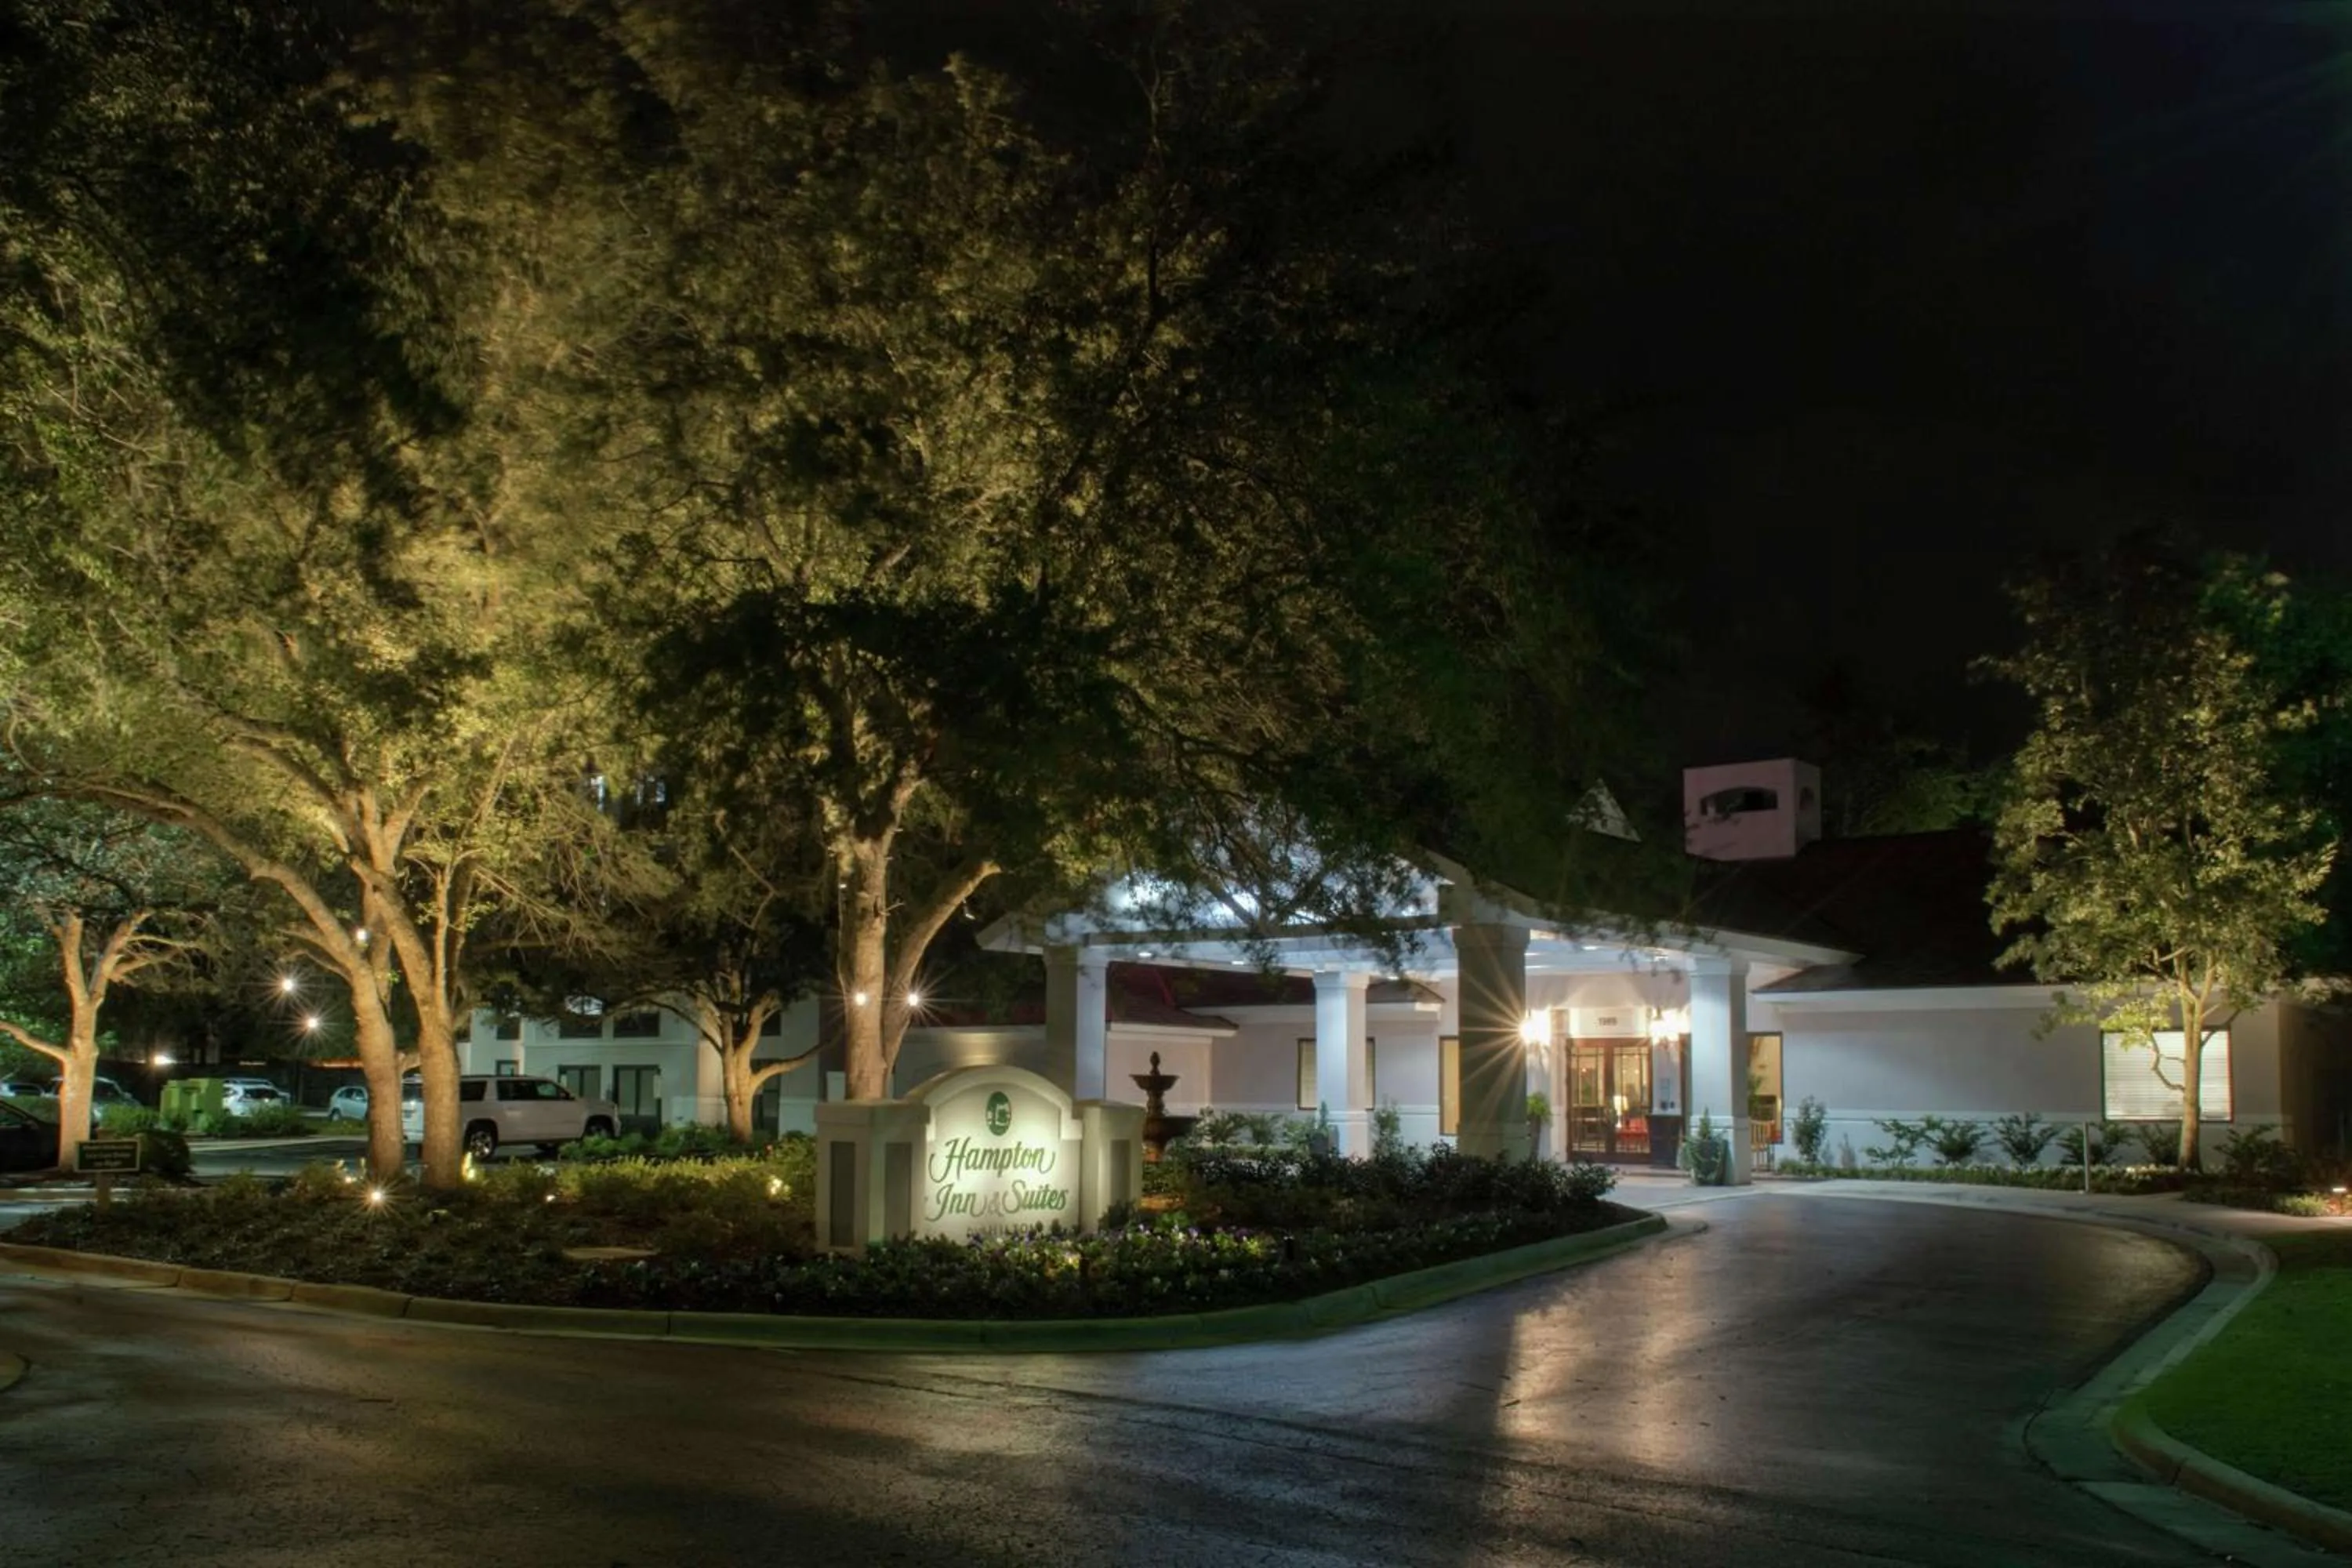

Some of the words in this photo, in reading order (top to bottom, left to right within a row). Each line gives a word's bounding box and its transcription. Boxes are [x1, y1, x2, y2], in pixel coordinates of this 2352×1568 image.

[928, 1137, 1055, 1183] Hampton
[925, 1182, 988, 1221] Inn
[987, 1190, 1004, 1218] &
[1002, 1179, 1069, 1215] Suites
